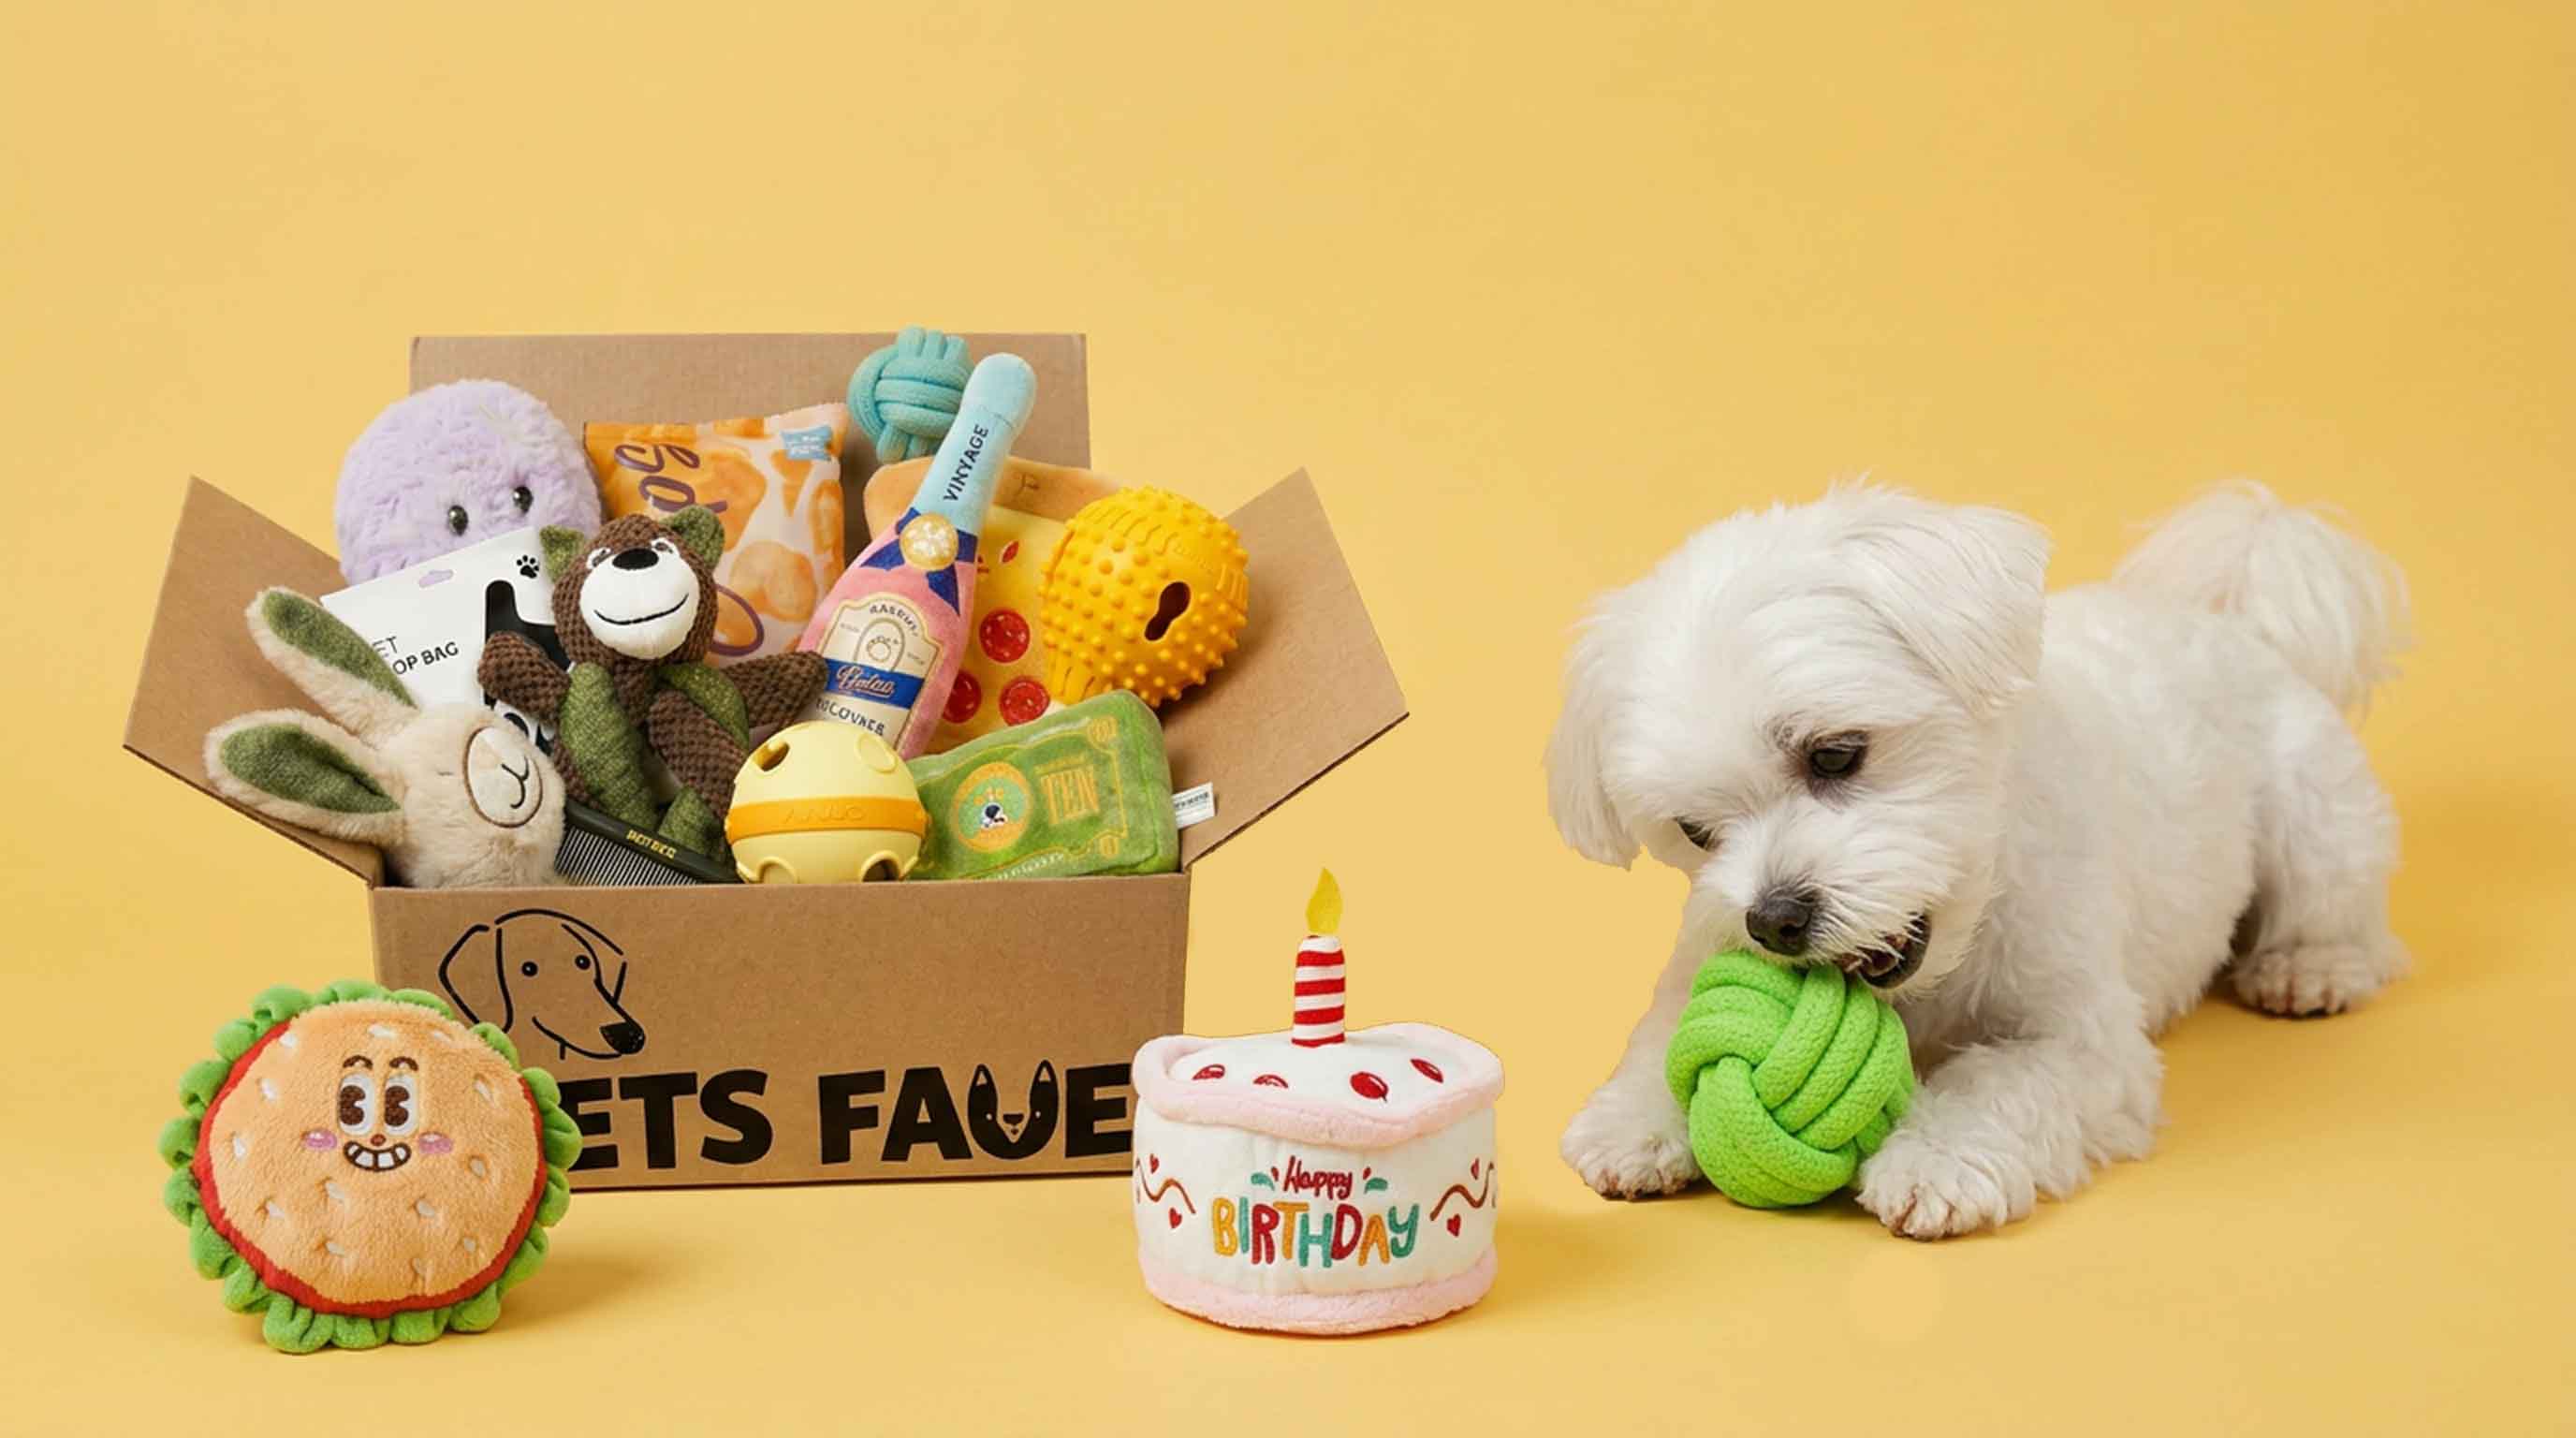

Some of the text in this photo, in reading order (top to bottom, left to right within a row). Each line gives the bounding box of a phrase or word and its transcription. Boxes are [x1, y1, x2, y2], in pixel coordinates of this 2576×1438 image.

[420, 641, 459, 666] BAG
[1040, 762, 1100, 826] TEN
[557, 1068, 773, 1172] ETS
[1283, 1154, 1354, 1200] Happy
[1212, 1196, 1420, 1269] BIRTHDAY
